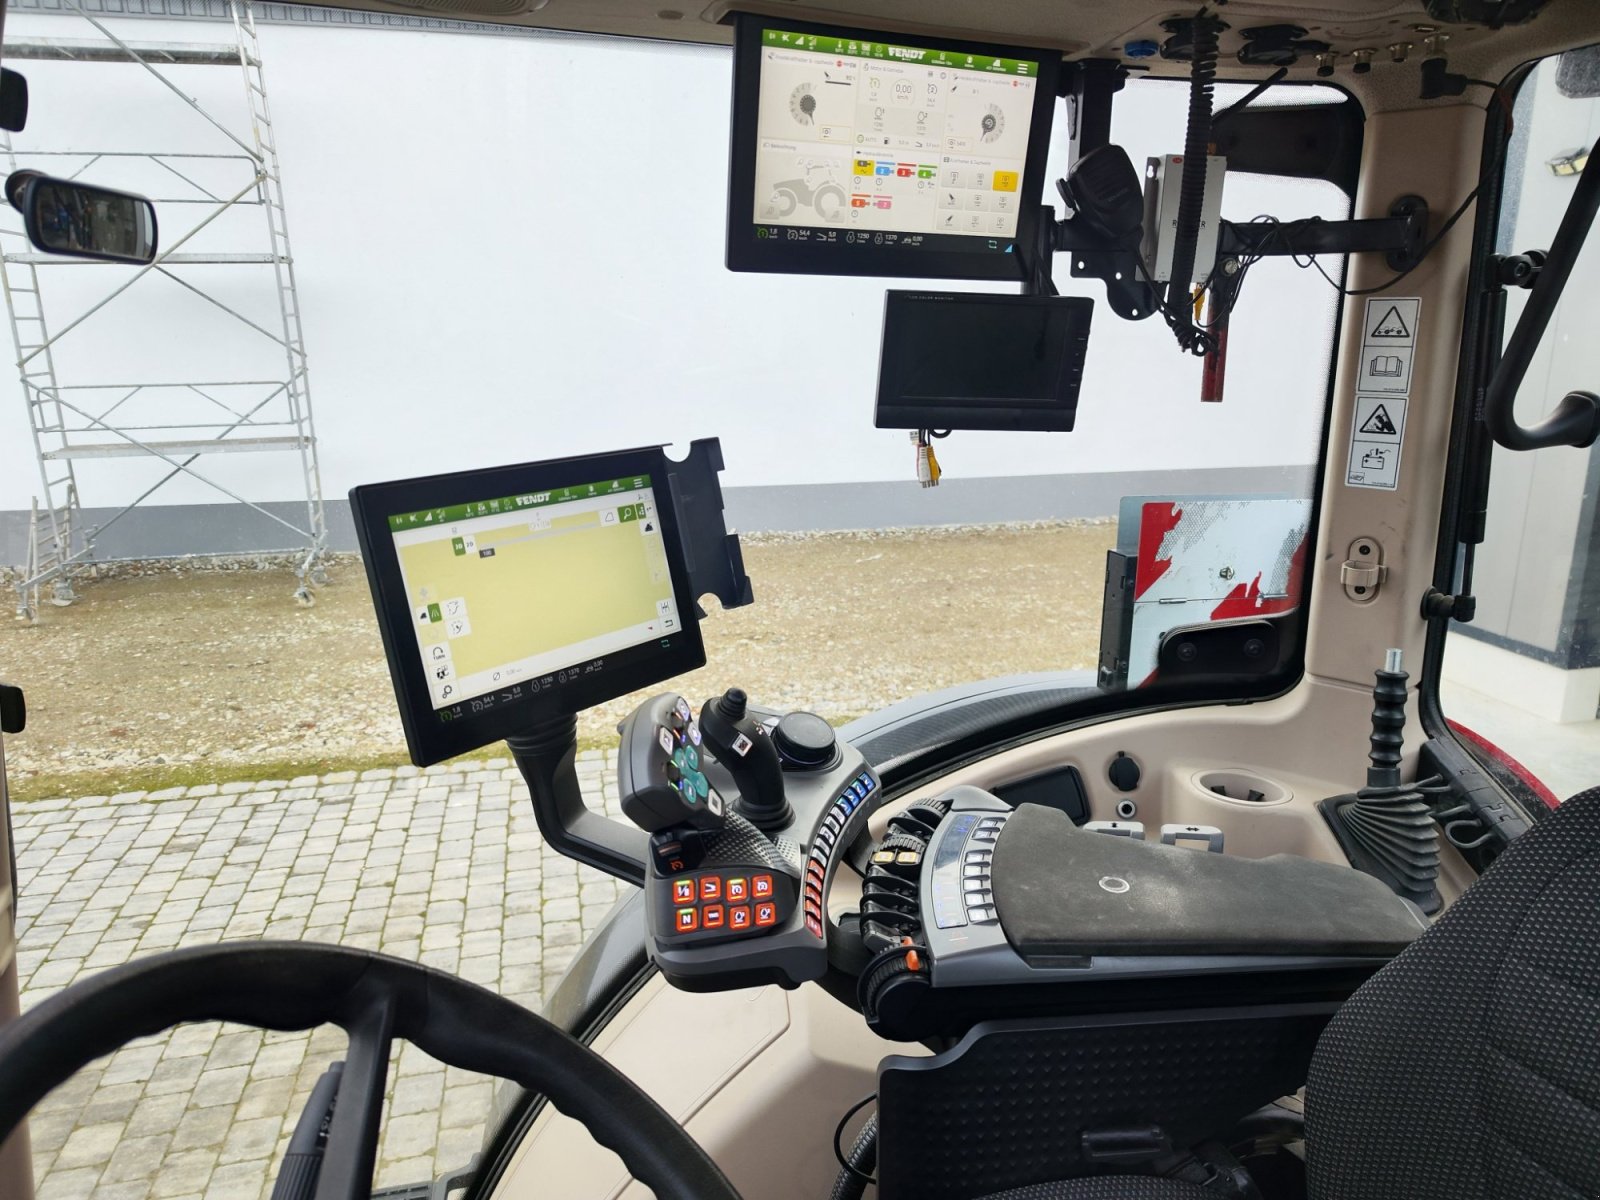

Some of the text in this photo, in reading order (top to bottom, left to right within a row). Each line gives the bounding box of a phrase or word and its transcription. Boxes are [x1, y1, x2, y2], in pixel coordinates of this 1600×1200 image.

[888, 47, 926, 59] FENDT
[516, 492, 551, 506] FENDT
[682, 914, 691, 924] N
